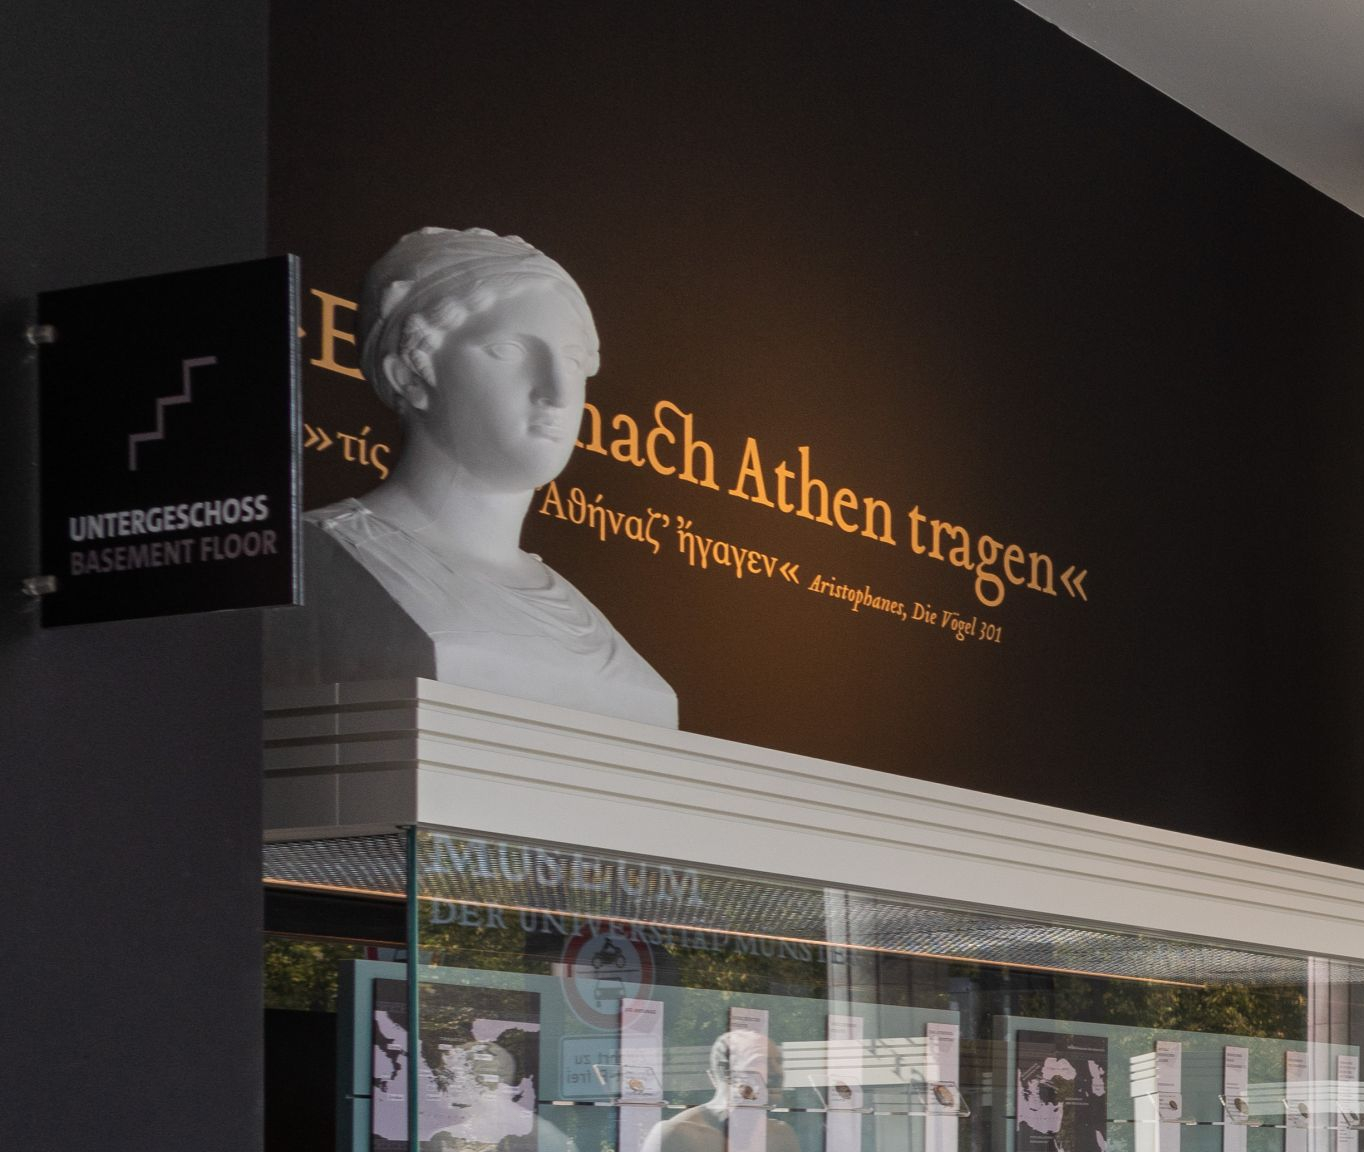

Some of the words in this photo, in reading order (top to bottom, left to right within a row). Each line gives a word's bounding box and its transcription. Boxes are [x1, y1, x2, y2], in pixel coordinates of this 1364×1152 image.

[69, 494, 269, 541] UNTERGESCHOSS
[728, 437, 896, 545] Athen
[70, 538, 196, 576] BASEMENT
[201, 530, 277, 562] FLOOR
[808, 574, 907, 621] Aristophanes,
[912, 602, 937, 624] Die
[979, 621, 1002, 643] 301
[425, 832, 703, 906] MUSEUM
[432, 900, 506, 930] DER
